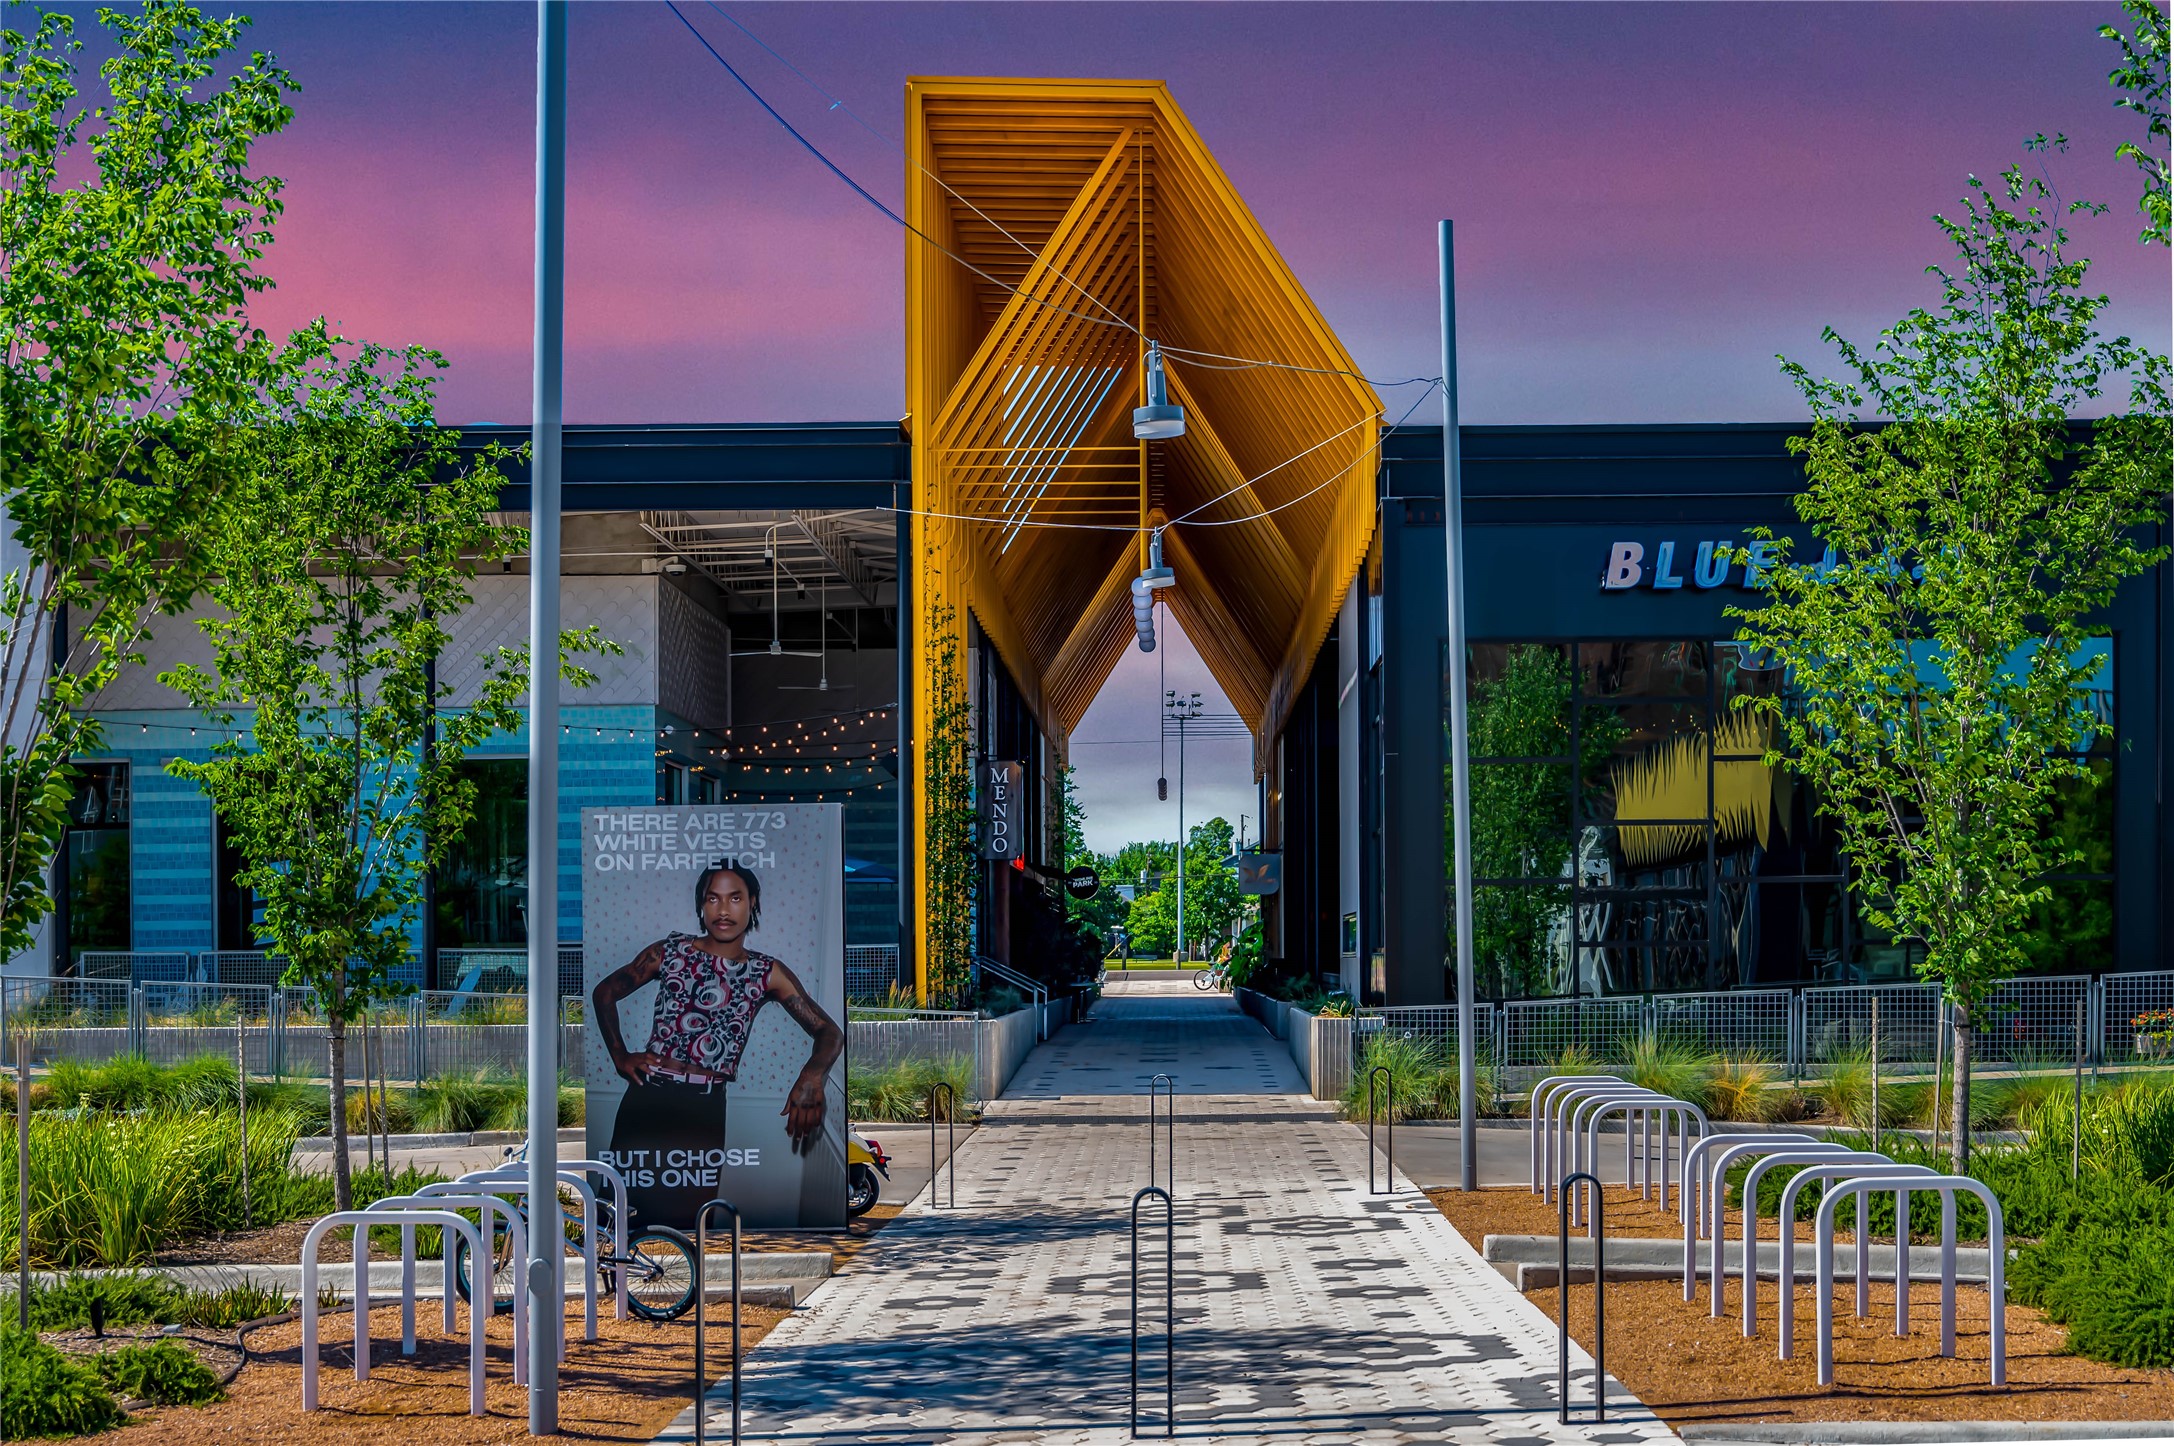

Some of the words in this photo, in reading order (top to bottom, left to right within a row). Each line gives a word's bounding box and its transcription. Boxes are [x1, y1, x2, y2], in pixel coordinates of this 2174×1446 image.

[1605, 540, 1779, 589] BLUE
[990, 767, 1010, 853] MENDO
[593, 813, 678, 832] THERE
[684, 812, 735, 831] ARE
[742, 811, 786, 830] 773
[593, 833, 677, 851] WHITE
[683, 832, 767, 850] VESTS
[594, 853, 634, 872] ON
[641, 852, 775, 871] FARFETCH
[1072, 880, 1093, 888] PARK
[598, 1150, 650, 1168] BUT
[655, 1150, 661, 1168] I
[666, 1149, 760, 1168] CHOSE
[661, 1169, 718, 1188] ONE
